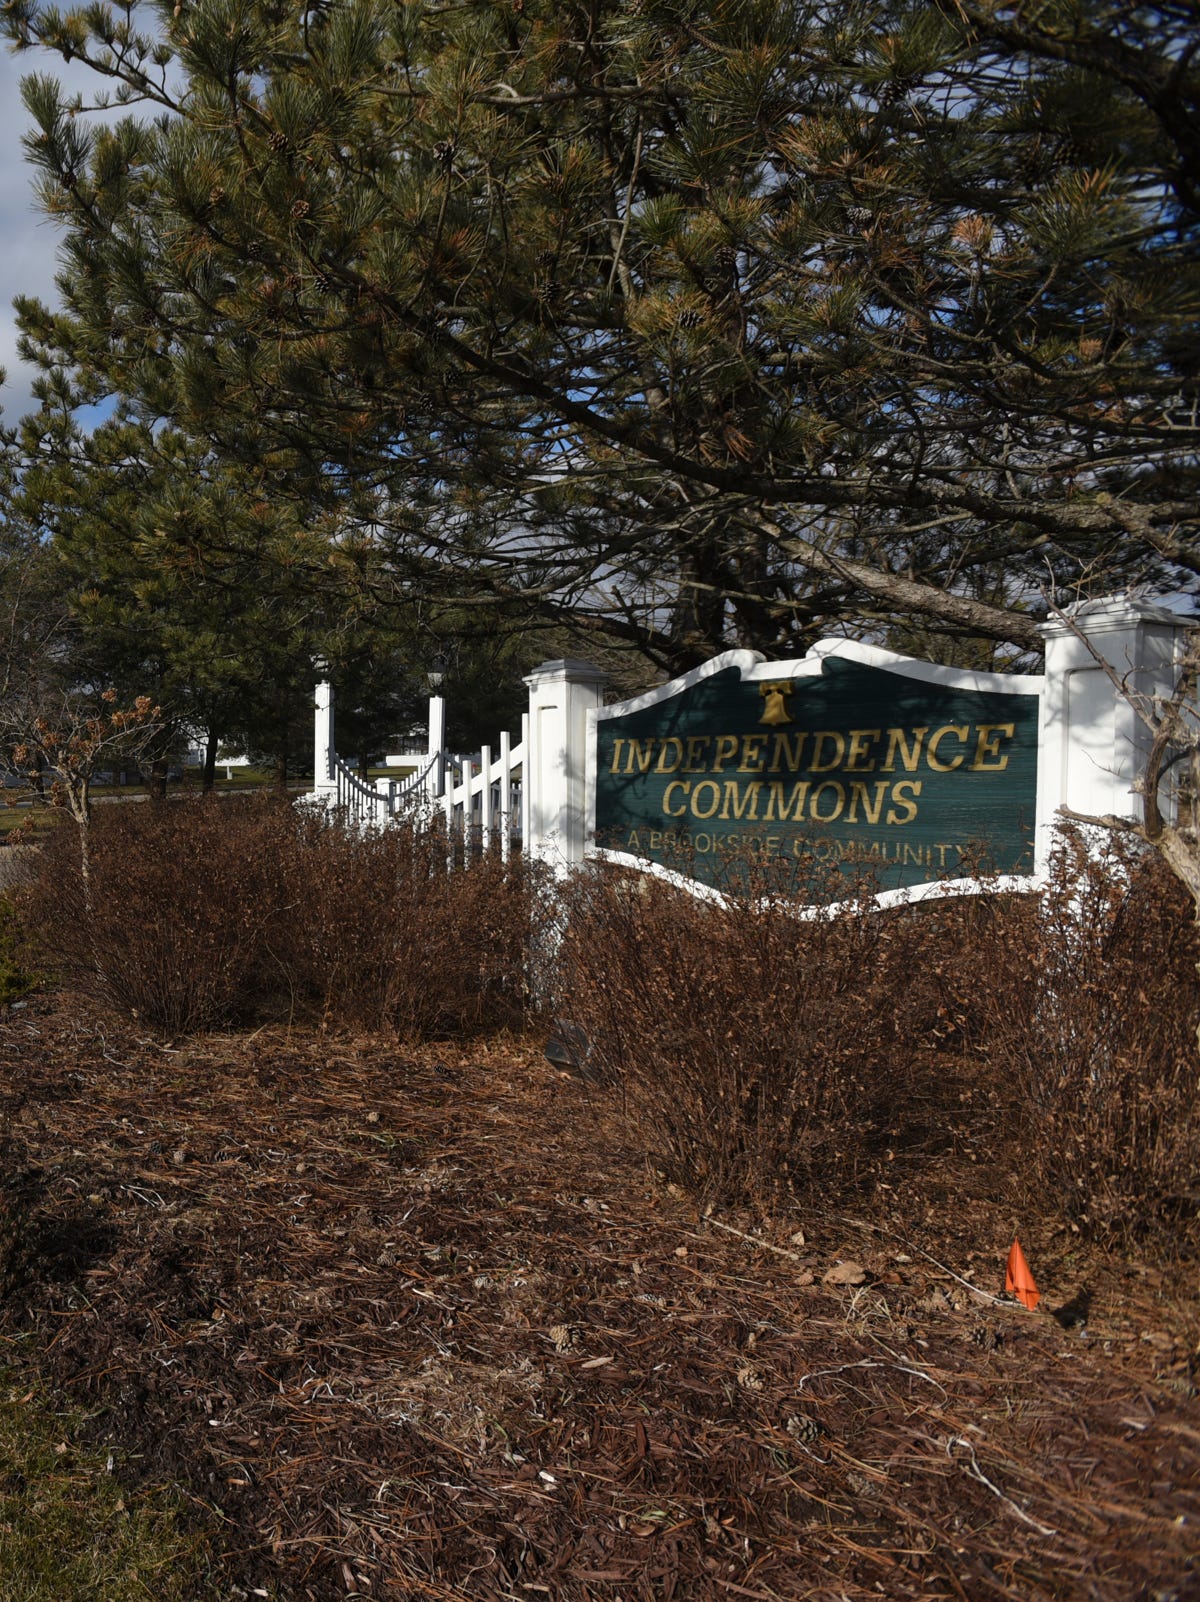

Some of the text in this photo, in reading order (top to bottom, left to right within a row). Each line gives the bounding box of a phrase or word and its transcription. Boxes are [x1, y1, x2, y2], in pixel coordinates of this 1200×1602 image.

[607, 722, 1016, 775] INDEPENDENCE
[662, 779, 923, 826] COMMONS
[627, 830, 640, 848] A
